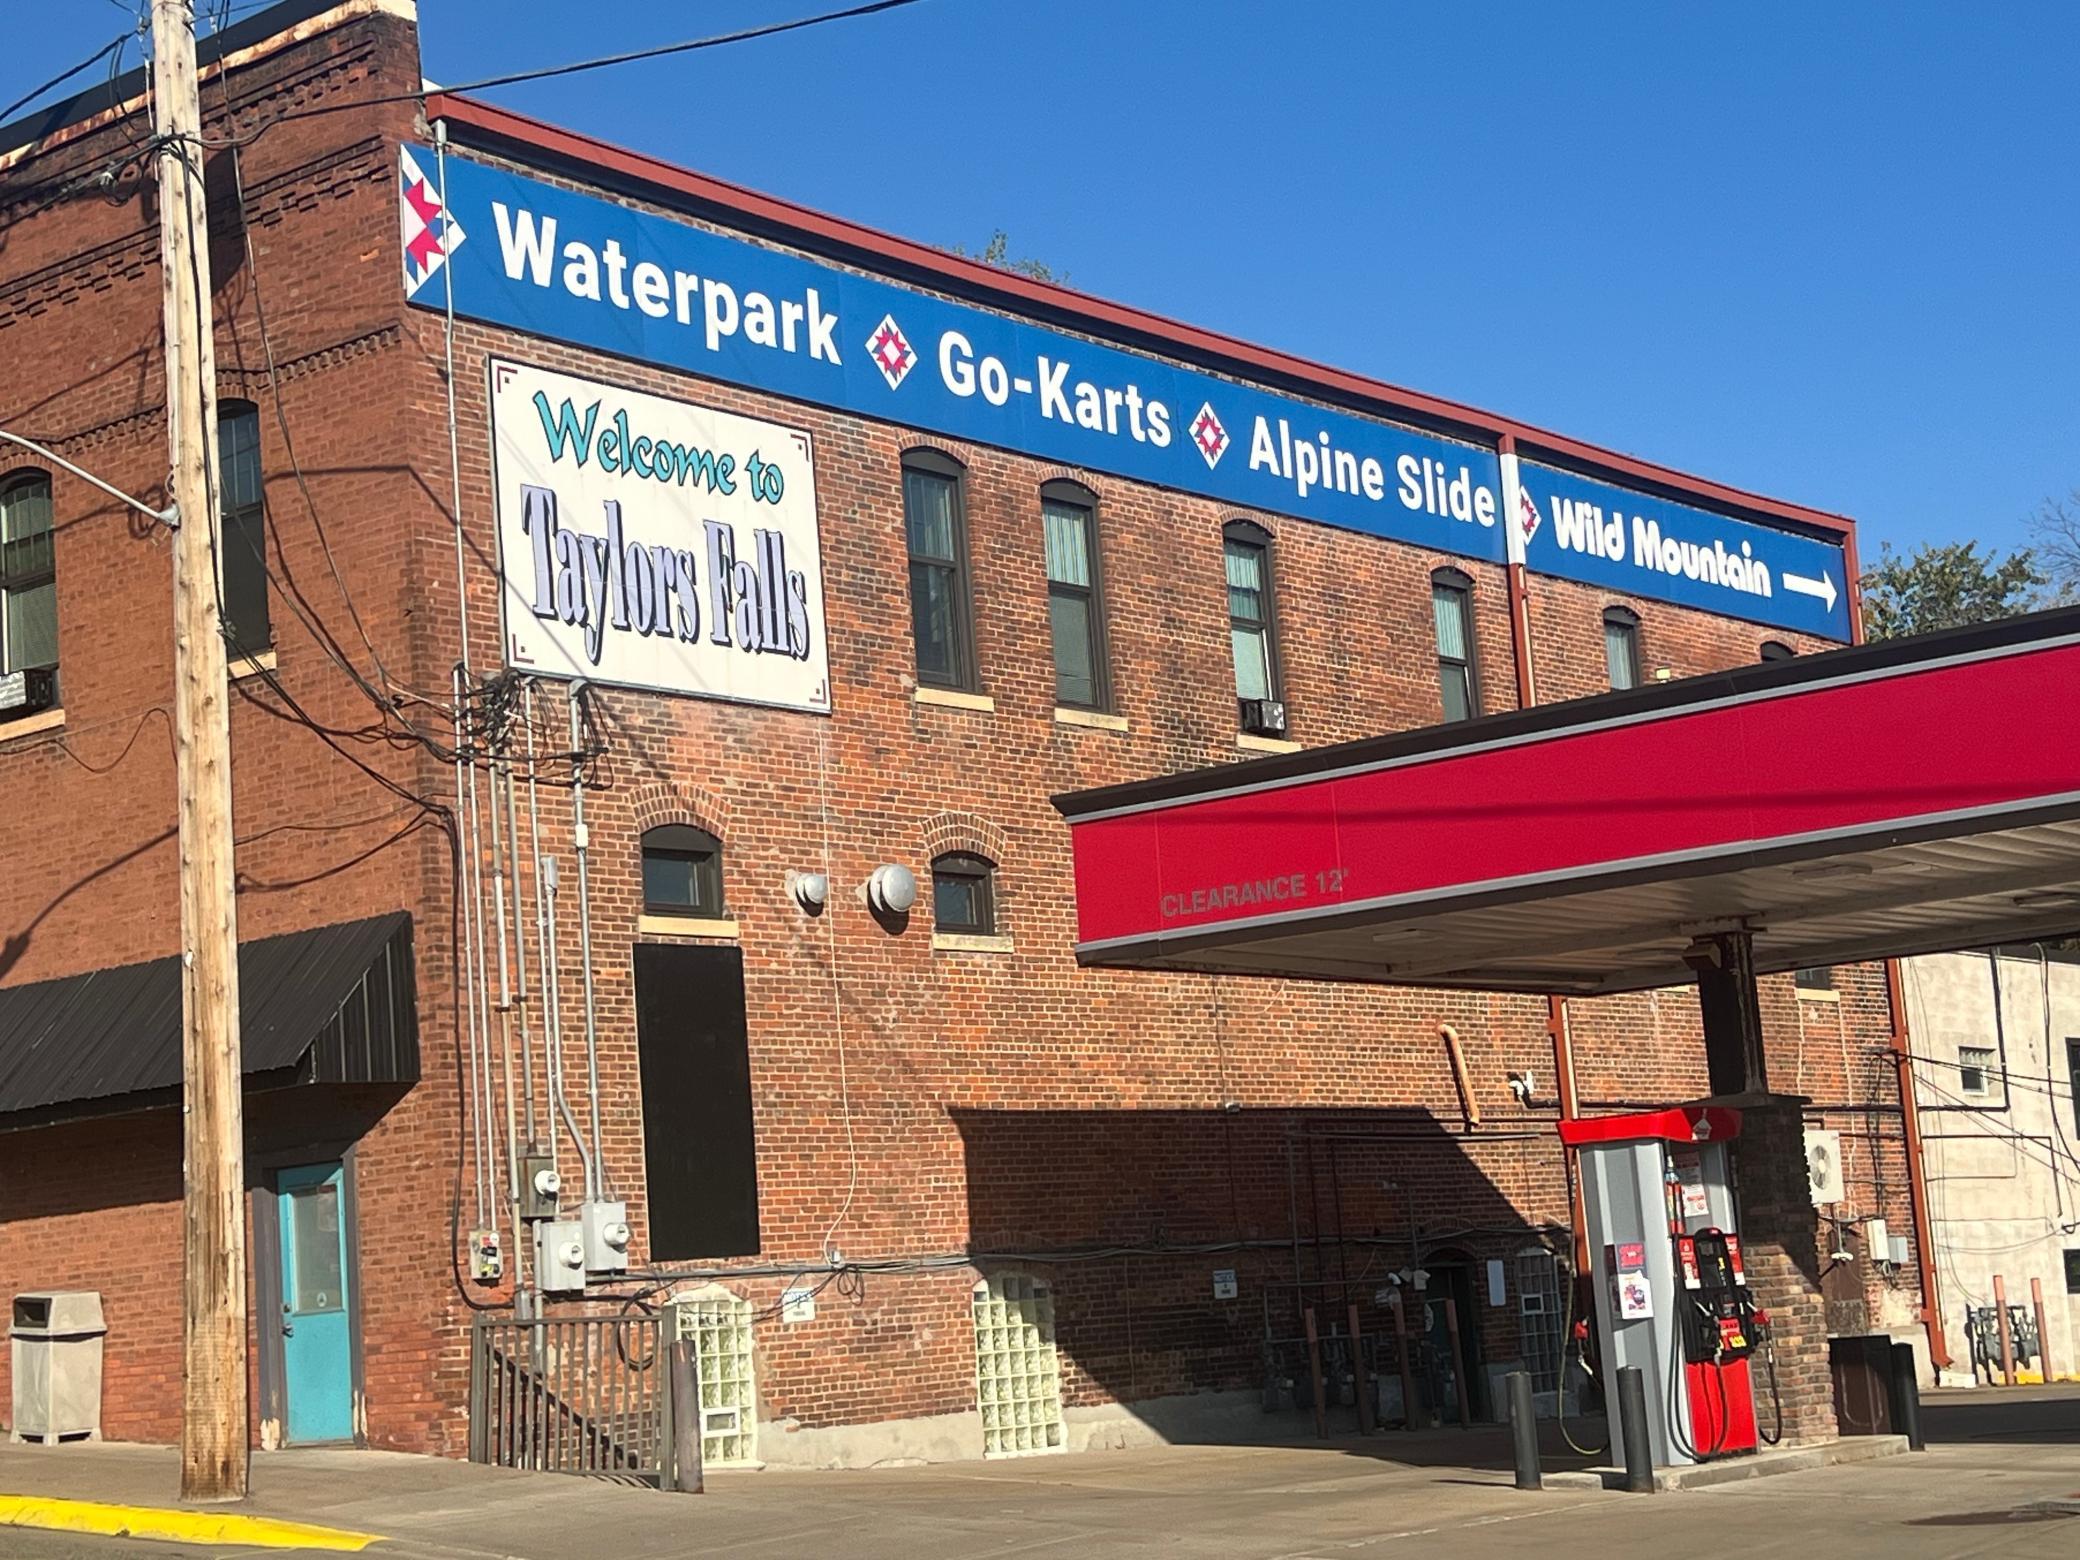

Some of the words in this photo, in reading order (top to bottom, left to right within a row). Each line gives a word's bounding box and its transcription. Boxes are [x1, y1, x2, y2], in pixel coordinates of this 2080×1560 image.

[491, 201, 842, 367] Waterpark
[532, 389, 738, 496] Welcome
[744, 449, 785, 505] to
[938, 330, 1172, 448] Go-Karts
[1249, 415, 1385, 501] Alpine
[1397, 453, 1496, 529] Slide
[520, 483, 700, 666] Taylors
[702, 518, 810, 662] Falls
[1550, 495, 1626, 562] Wild
[1631, 515, 1773, 598] Mountain
[1161, 873, 1308, 918] CLEARANCE
